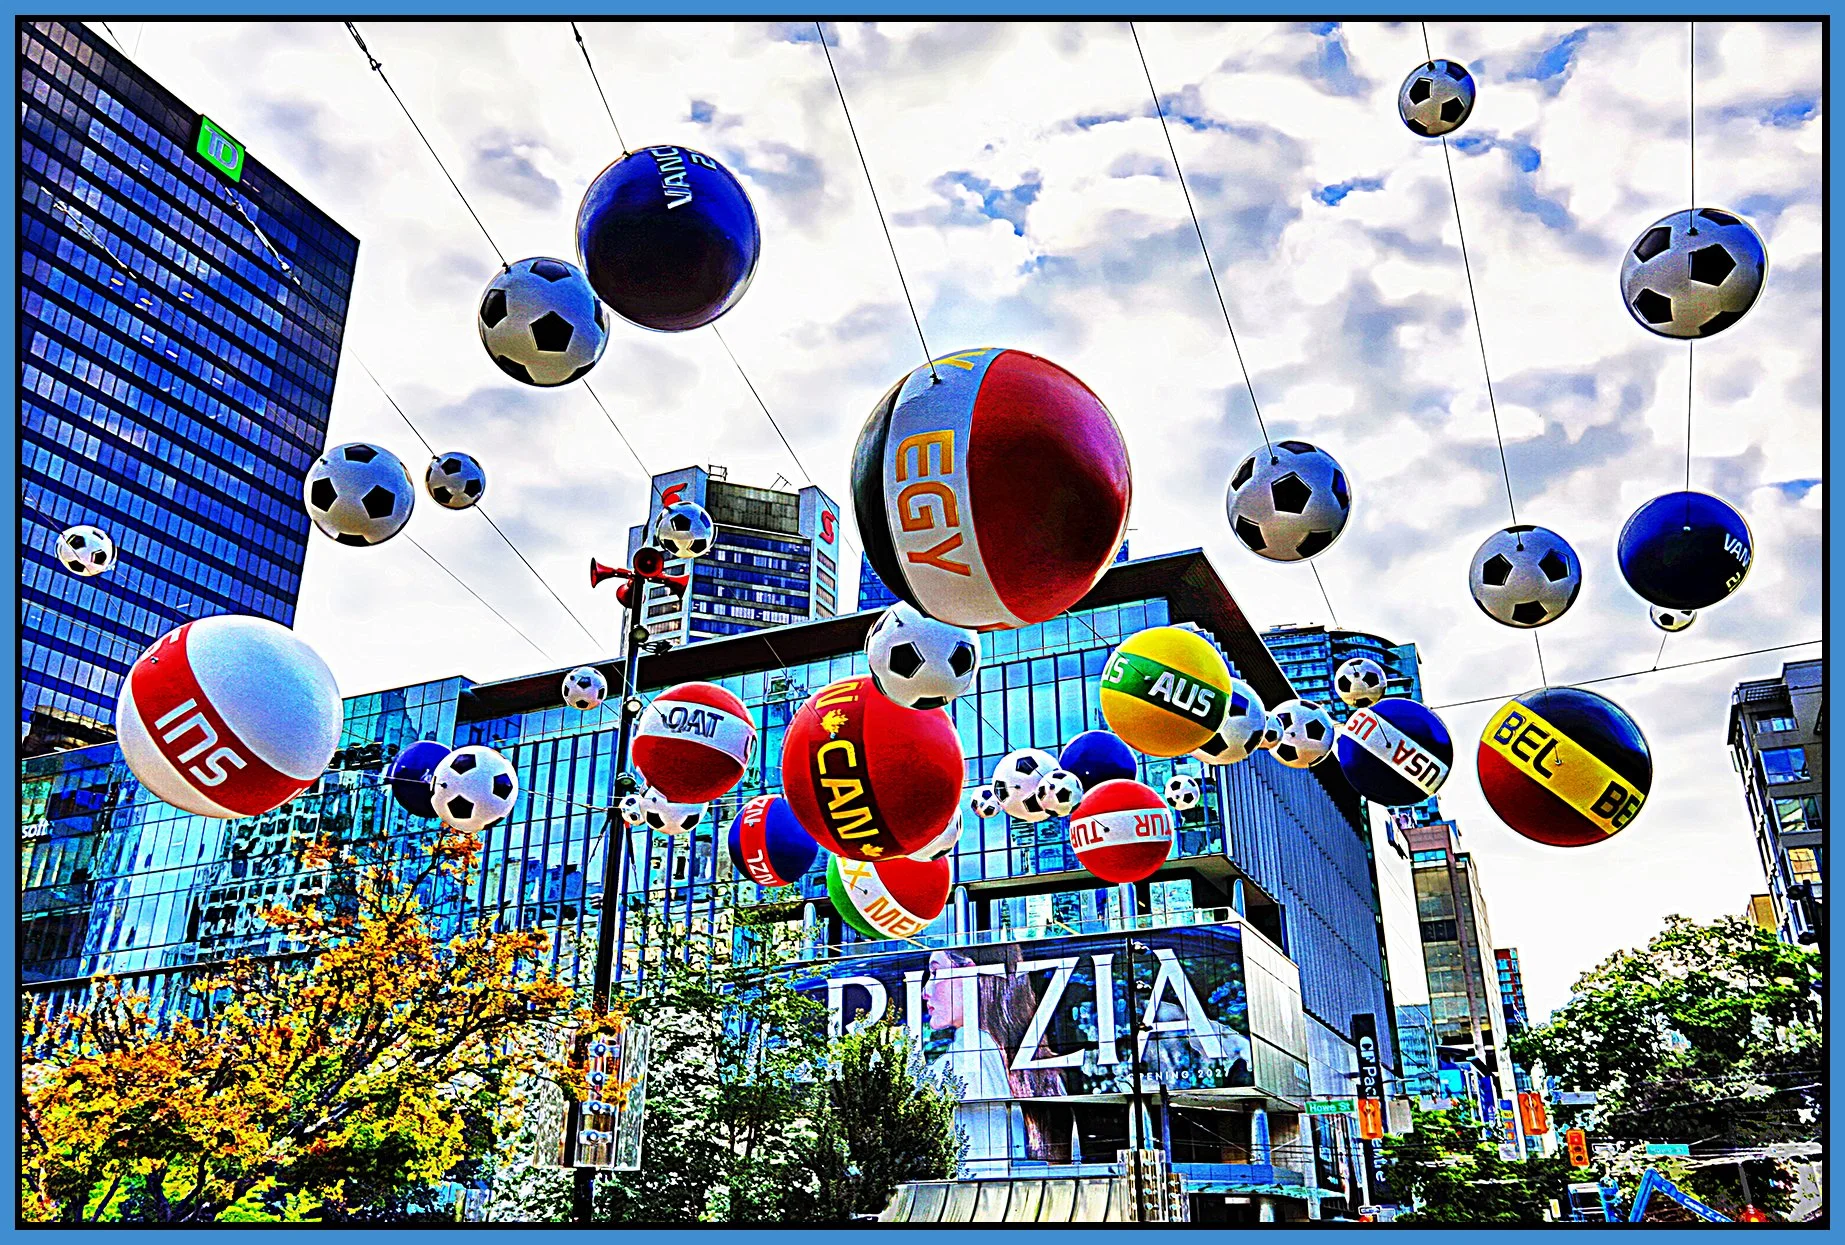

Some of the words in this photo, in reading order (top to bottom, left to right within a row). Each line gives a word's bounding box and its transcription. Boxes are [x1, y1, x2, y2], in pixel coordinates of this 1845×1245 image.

[205, 125, 239, 170] TD
[895, 430, 971, 577] EGY
[1147, 671, 1216, 718] AUS
[1392, 739, 1441, 788] USA
[1493, 711, 1560, 780] BEL
[817, 739, 880, 839] CAN
[1309, 1103, 1336, 1112] Howe
[1338, 1102, 1351, 1111] St
